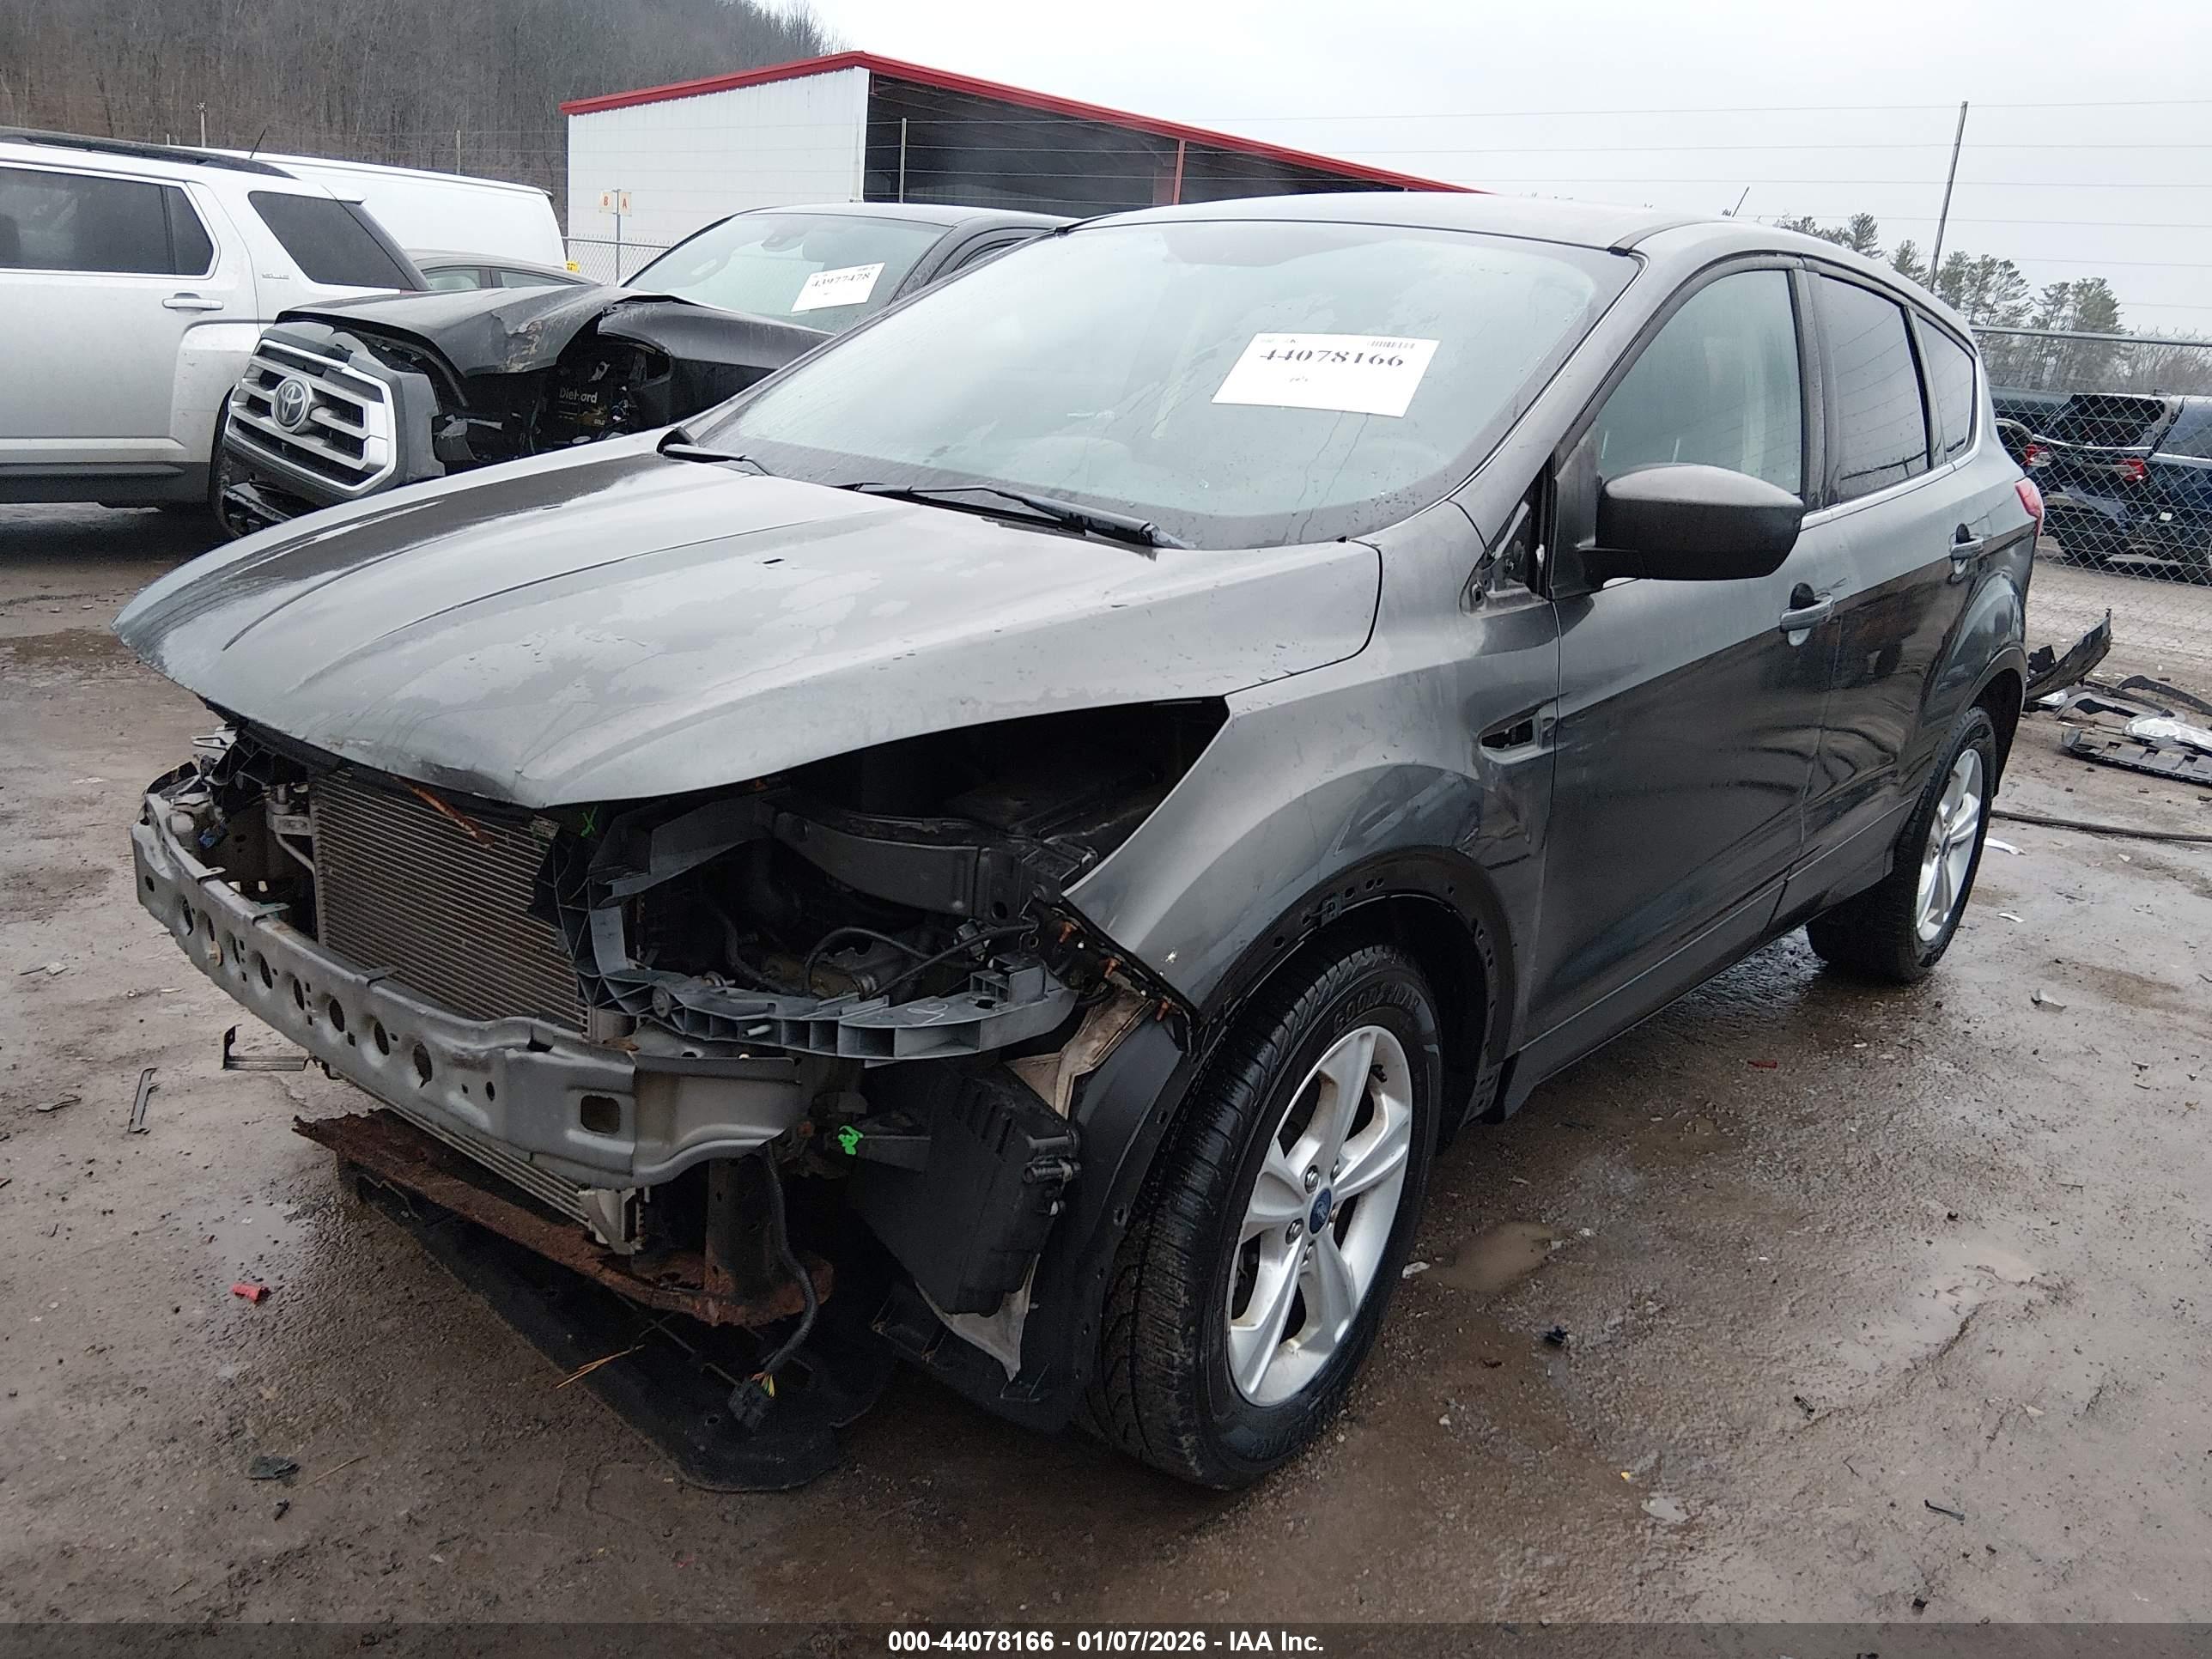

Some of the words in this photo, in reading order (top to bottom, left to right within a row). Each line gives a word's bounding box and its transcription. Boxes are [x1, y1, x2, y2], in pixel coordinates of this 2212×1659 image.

[604, 196, 609, 206] B
[623, 198, 628, 209] A
[1260, 349, 1404, 367] 44078166
